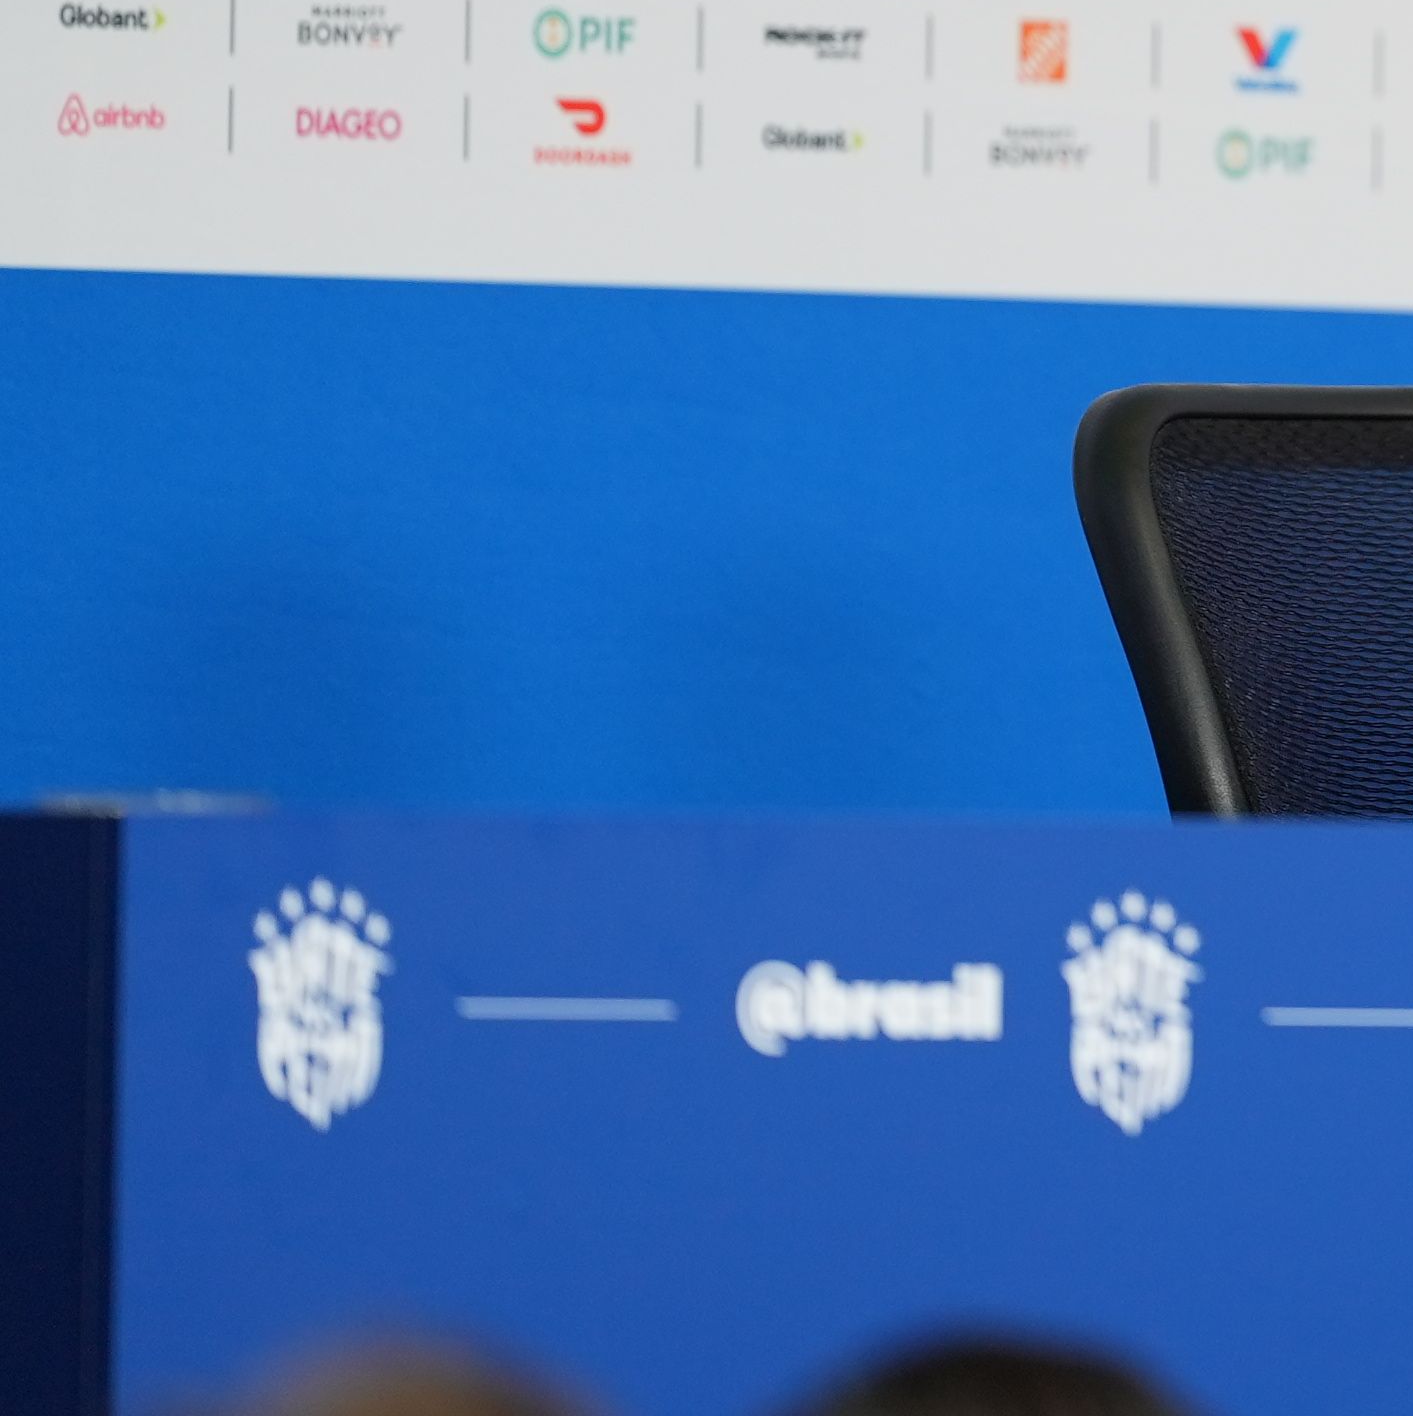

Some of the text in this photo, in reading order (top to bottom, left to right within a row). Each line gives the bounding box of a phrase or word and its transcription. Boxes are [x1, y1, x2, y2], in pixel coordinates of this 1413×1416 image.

[60, 4, 148, 29] Globant
[579, 16, 634, 52] PIF
[93, 106, 165, 128] airbnb
[296, 107, 402, 140] DIAGEO
[737, 962, 1002, 1054] @brasil
